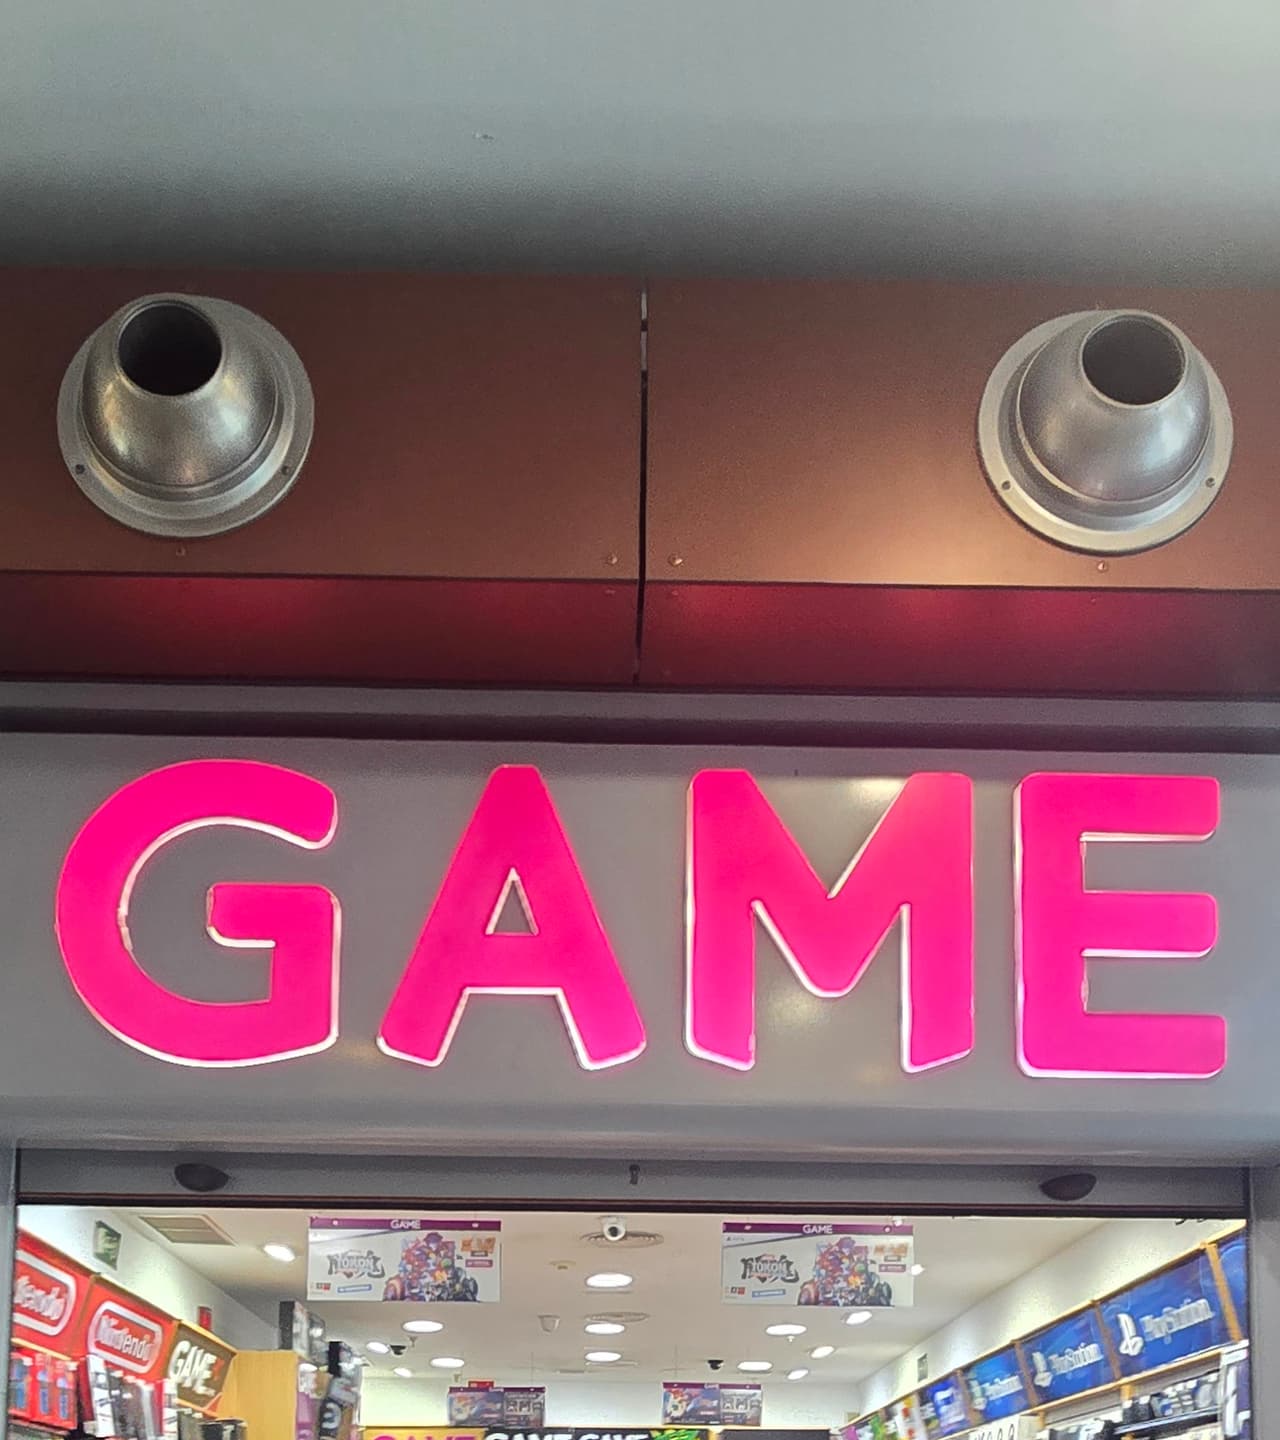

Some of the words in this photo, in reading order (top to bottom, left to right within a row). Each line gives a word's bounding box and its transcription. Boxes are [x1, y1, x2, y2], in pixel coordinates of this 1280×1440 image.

[54, 758, 1226, 1078] GAME
[391, 1219, 422, 1230] GAME
[802, 1224, 833, 1235] GAME
[95, 1314, 157, 1362] Nintendo
[170, 1341, 218, 1382] GAME
